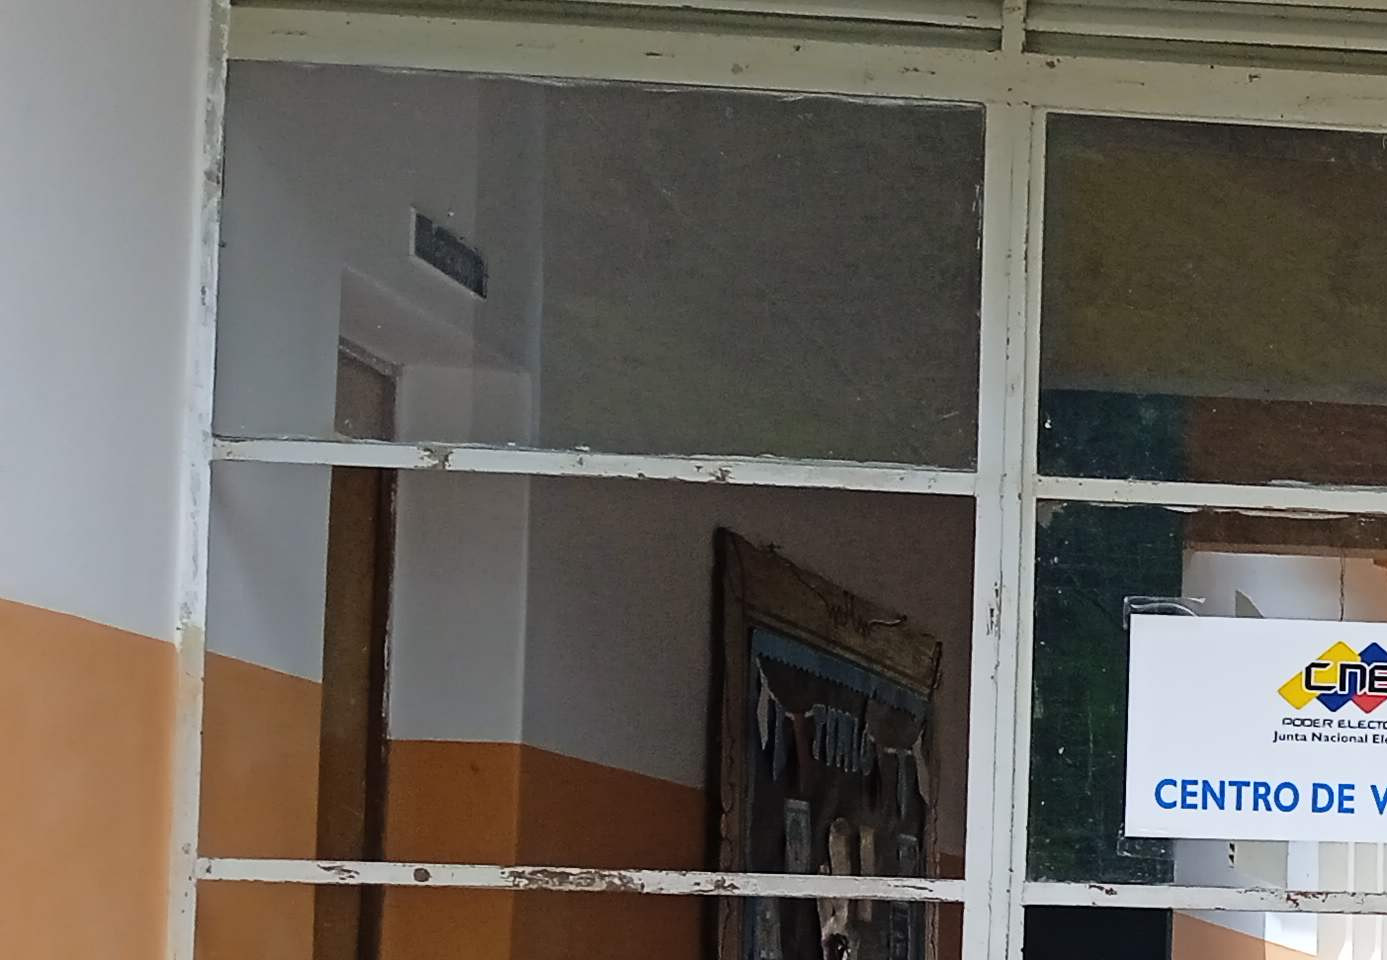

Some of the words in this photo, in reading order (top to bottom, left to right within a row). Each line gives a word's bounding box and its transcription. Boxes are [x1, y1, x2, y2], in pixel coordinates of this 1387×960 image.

[1282, 717, 1334, 729] PODER
[1272, 730, 1307, 743] Junta
[1311, 731, 1368, 744] Nacional
[1154, 778, 1300, 814] CENTRO
[1311, 783, 1355, 815] DE
